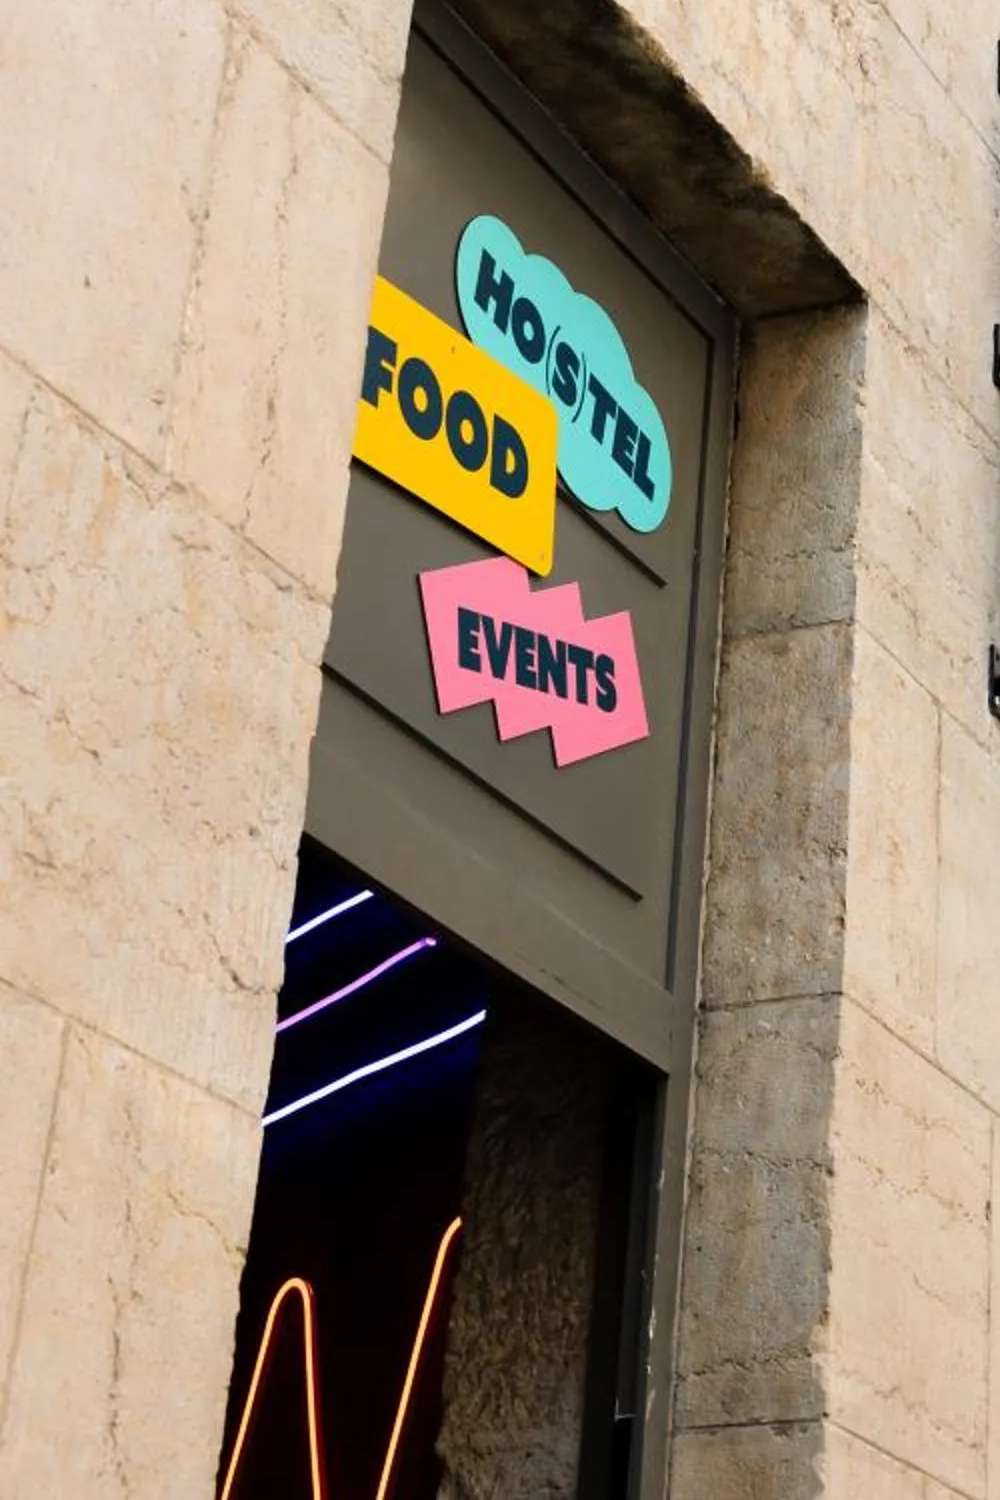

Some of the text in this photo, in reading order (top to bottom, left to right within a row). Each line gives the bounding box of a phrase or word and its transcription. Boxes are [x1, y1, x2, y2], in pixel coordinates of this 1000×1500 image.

[361, 325, 529, 499] FOOD
[474, 248, 655, 501] HO(S)TEL
[457, 606, 617, 713] EVENTS
